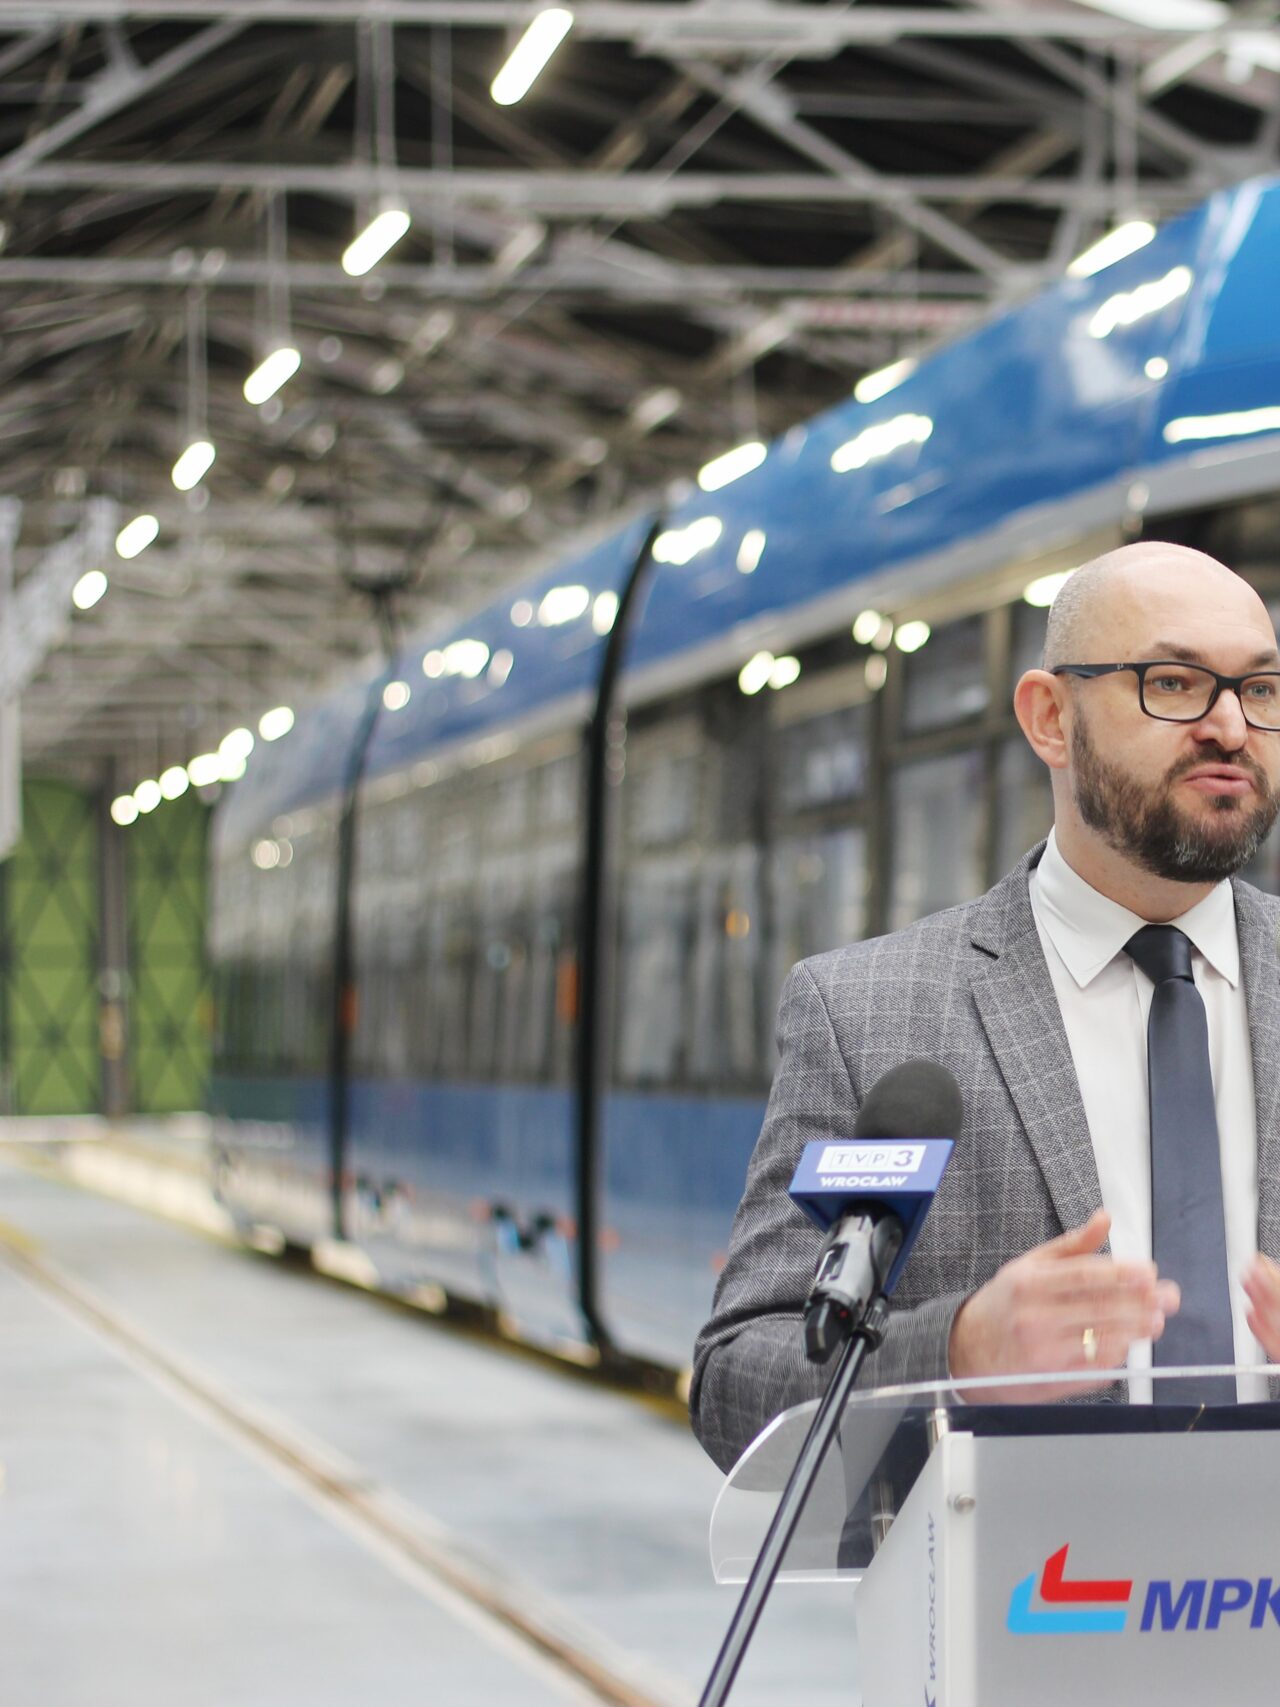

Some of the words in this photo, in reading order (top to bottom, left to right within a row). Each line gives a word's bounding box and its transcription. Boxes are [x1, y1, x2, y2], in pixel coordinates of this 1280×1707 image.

[836, 1152, 886, 1165] TVP
[893, 1150, 913, 1167] 3
[820, 1175, 908, 1188] WROCŁAW
